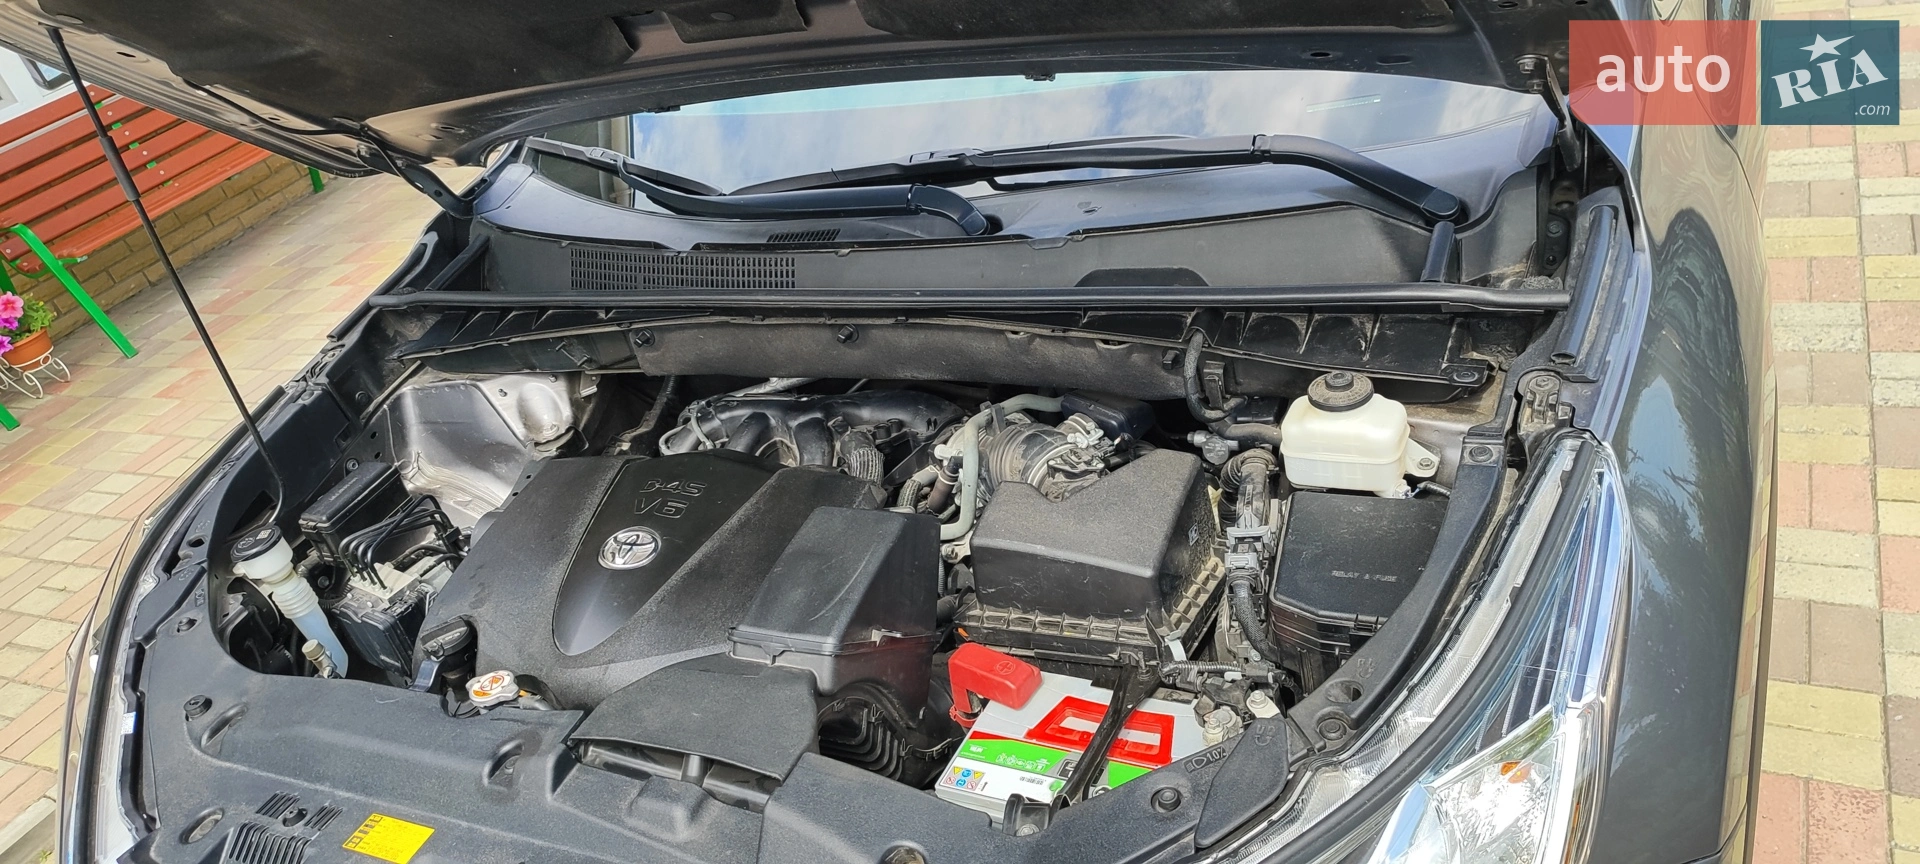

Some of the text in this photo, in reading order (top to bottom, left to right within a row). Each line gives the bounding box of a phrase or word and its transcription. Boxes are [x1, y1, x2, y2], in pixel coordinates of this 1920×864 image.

[634, 497, 690, 519] V6
[1331, 570, 1361, 579] RELAY
[1373, 574, 1398, 583] FUSE
